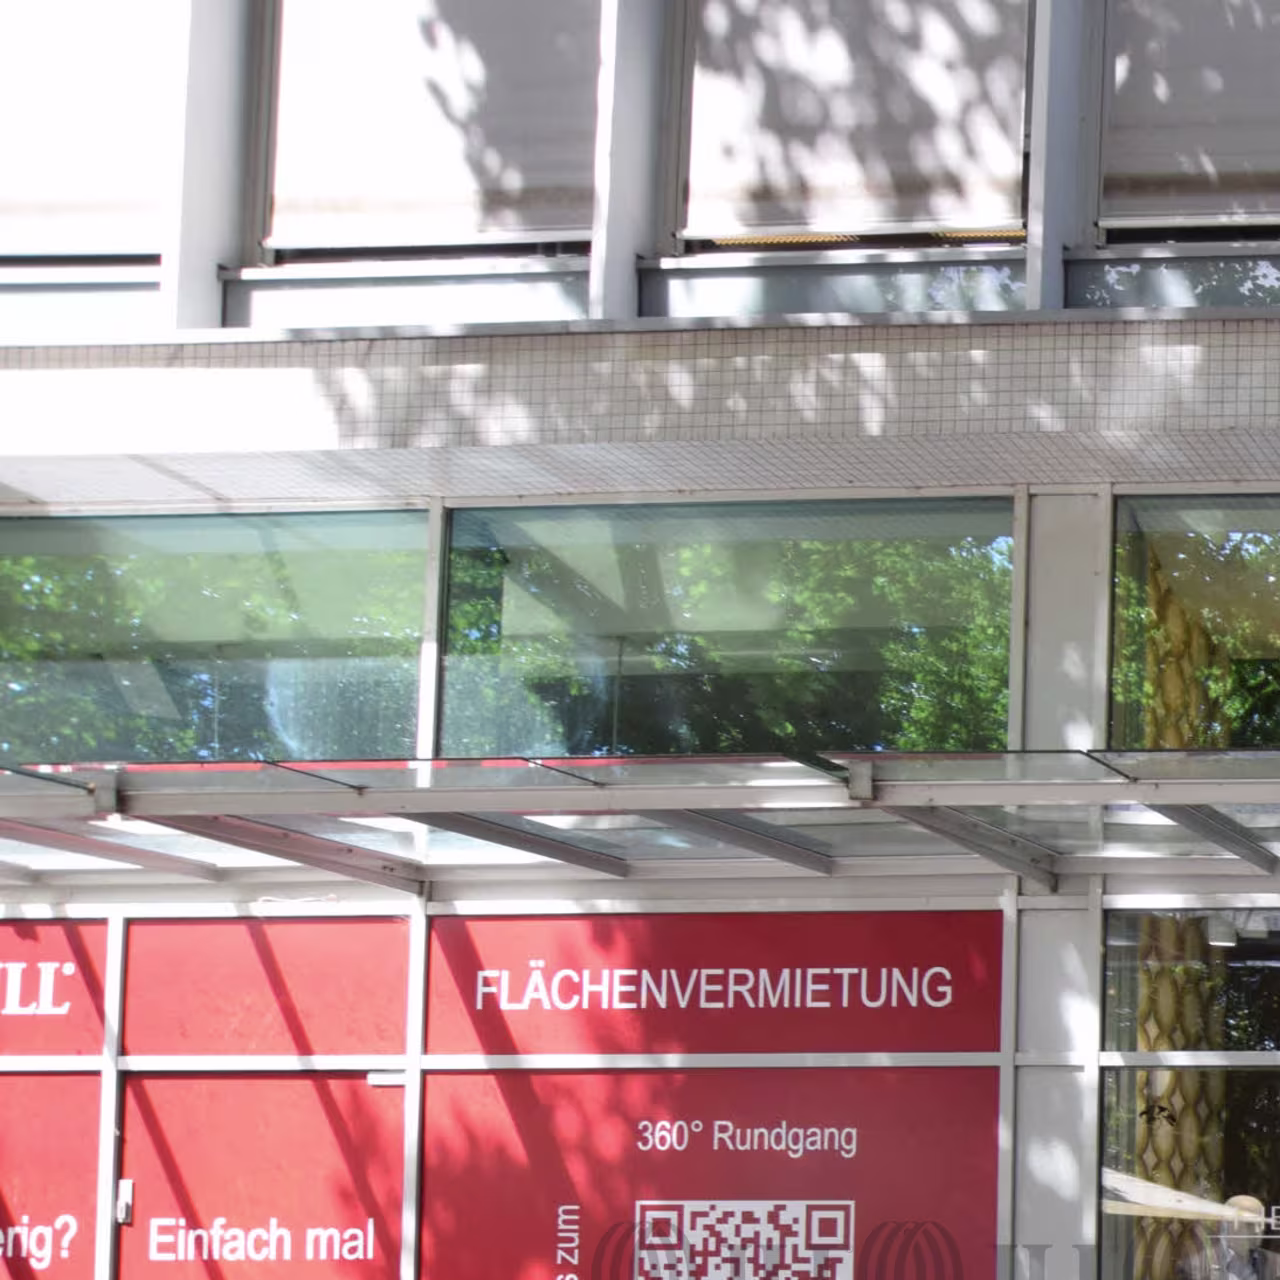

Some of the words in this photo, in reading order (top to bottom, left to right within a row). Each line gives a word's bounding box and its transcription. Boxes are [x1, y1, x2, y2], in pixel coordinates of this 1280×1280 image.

[0, 961, 72, 1015] LL
[475, 959, 953, 1010] FLÄCHENVERMIETUNG
[636, 1120, 704, 1151] 360°
[712, 1120, 858, 1158] Rundgang
[149, 1217, 291, 1261] Einfach
[305, 1217, 375, 1261] mal
[556, 1204, 580, 1265] zum
